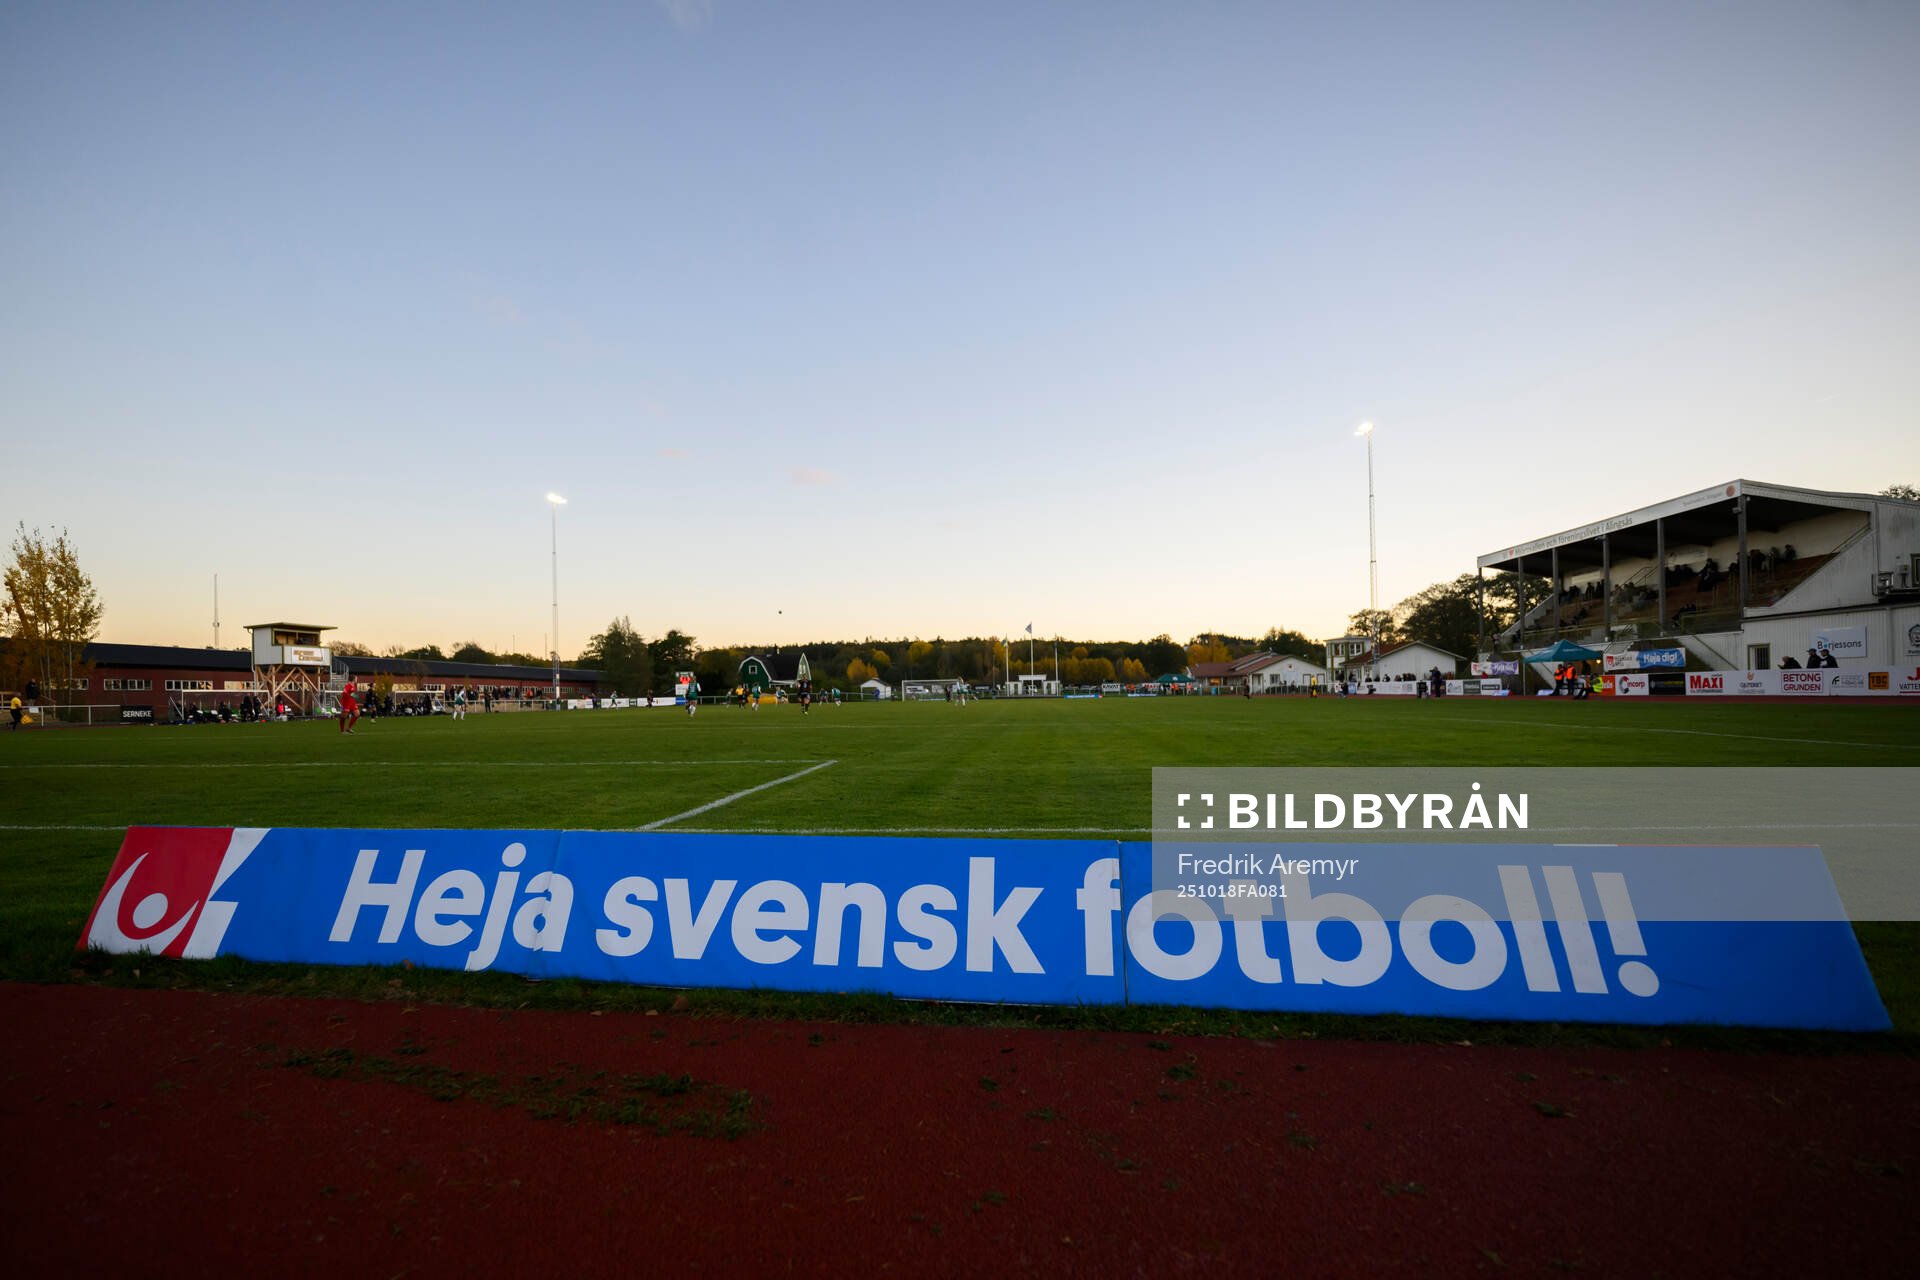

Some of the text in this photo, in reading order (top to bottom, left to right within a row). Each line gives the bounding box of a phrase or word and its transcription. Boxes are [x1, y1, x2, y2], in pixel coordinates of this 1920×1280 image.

[1690, 675, 1723, 689] MAXI
[1783, 673, 1821, 682] BETONG
[122, 710, 152, 718] SERNEKE
[329, 843, 1660, 998] Heja svensk fotboll!
